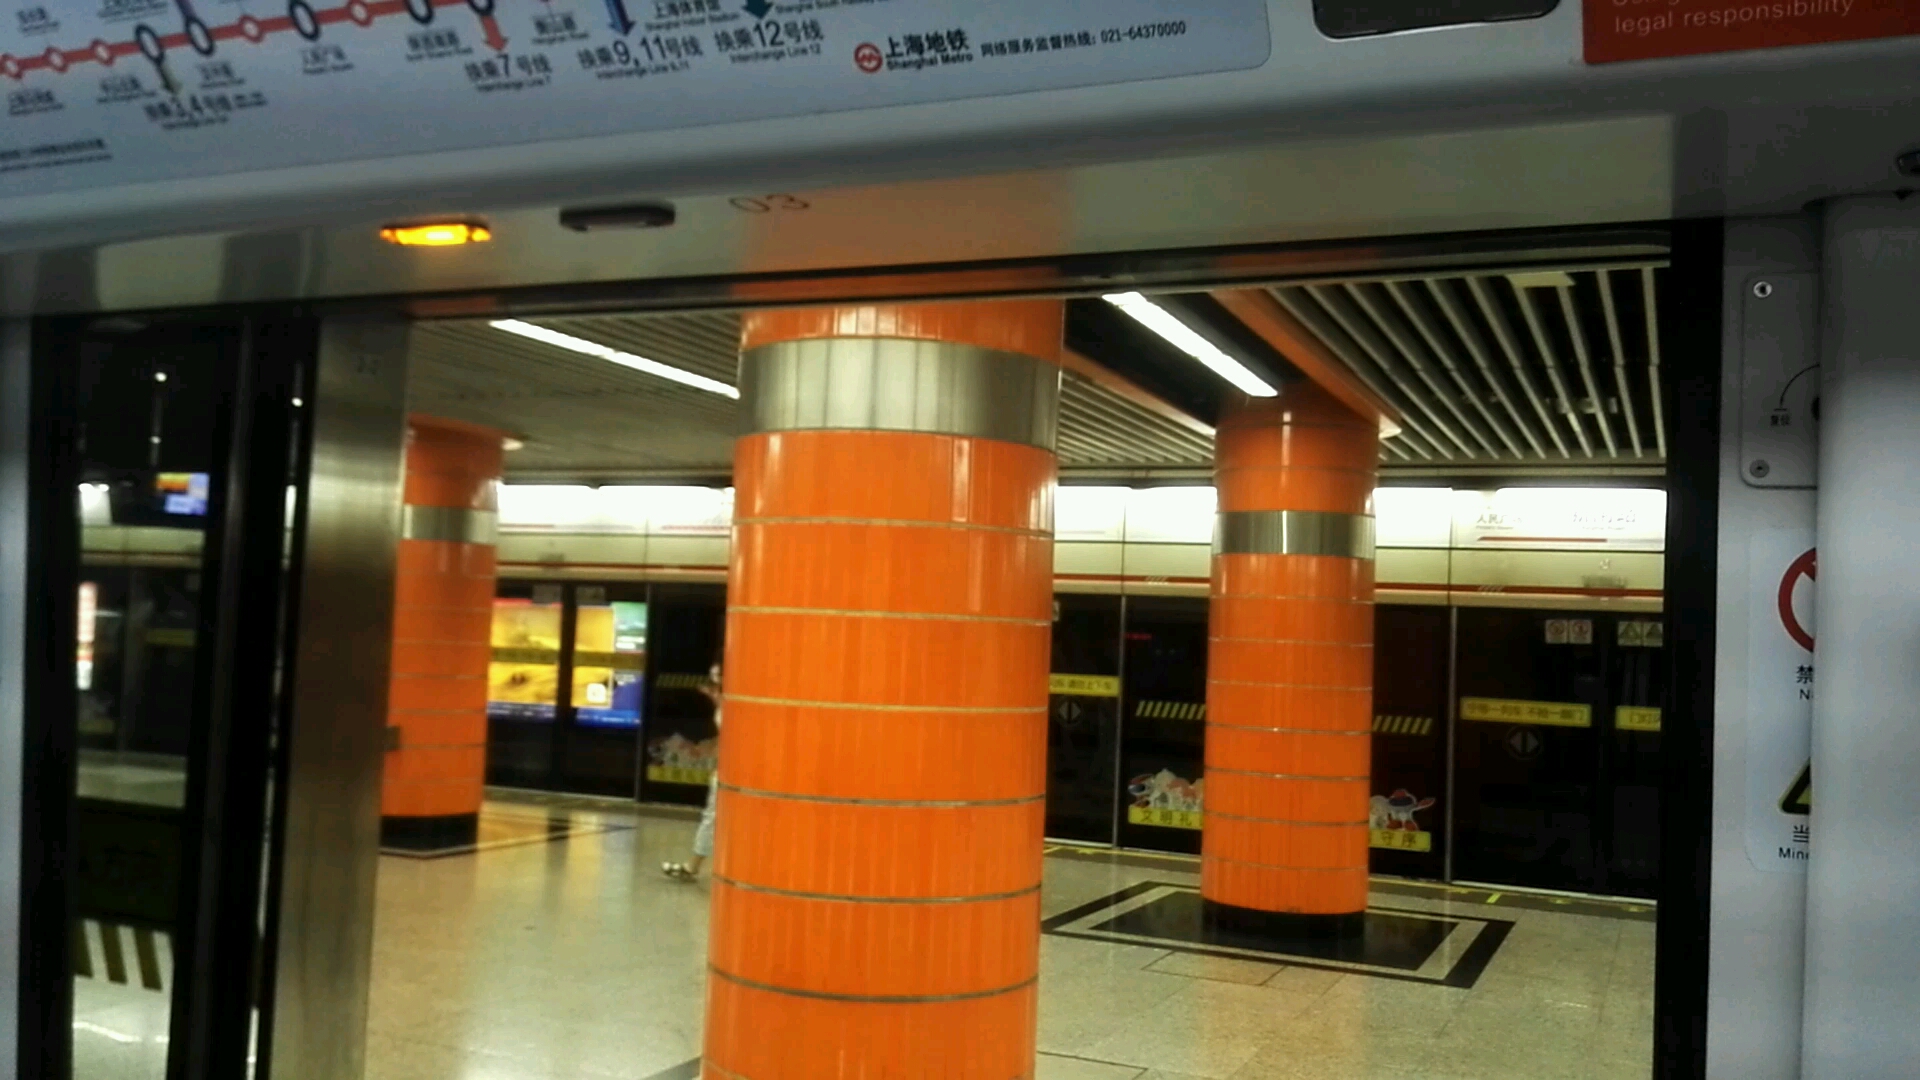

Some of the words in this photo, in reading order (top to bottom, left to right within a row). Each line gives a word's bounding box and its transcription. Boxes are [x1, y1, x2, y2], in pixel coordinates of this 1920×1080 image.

[1614, 10, 1673, 37] legal
[1683, 0, 1853, 27] responsibility
[1100, 20, 1187, 44] 021-64370000
[885, 28, 970, 58] 上海地铁
[887, 55, 938, 71] Shanghai
[940, 52, 974, 65] Metro
[729, 193, 810, 213] 03
[1799, 688, 1814, 701] N
[1140, 809, 1203, 826] 文明礼
